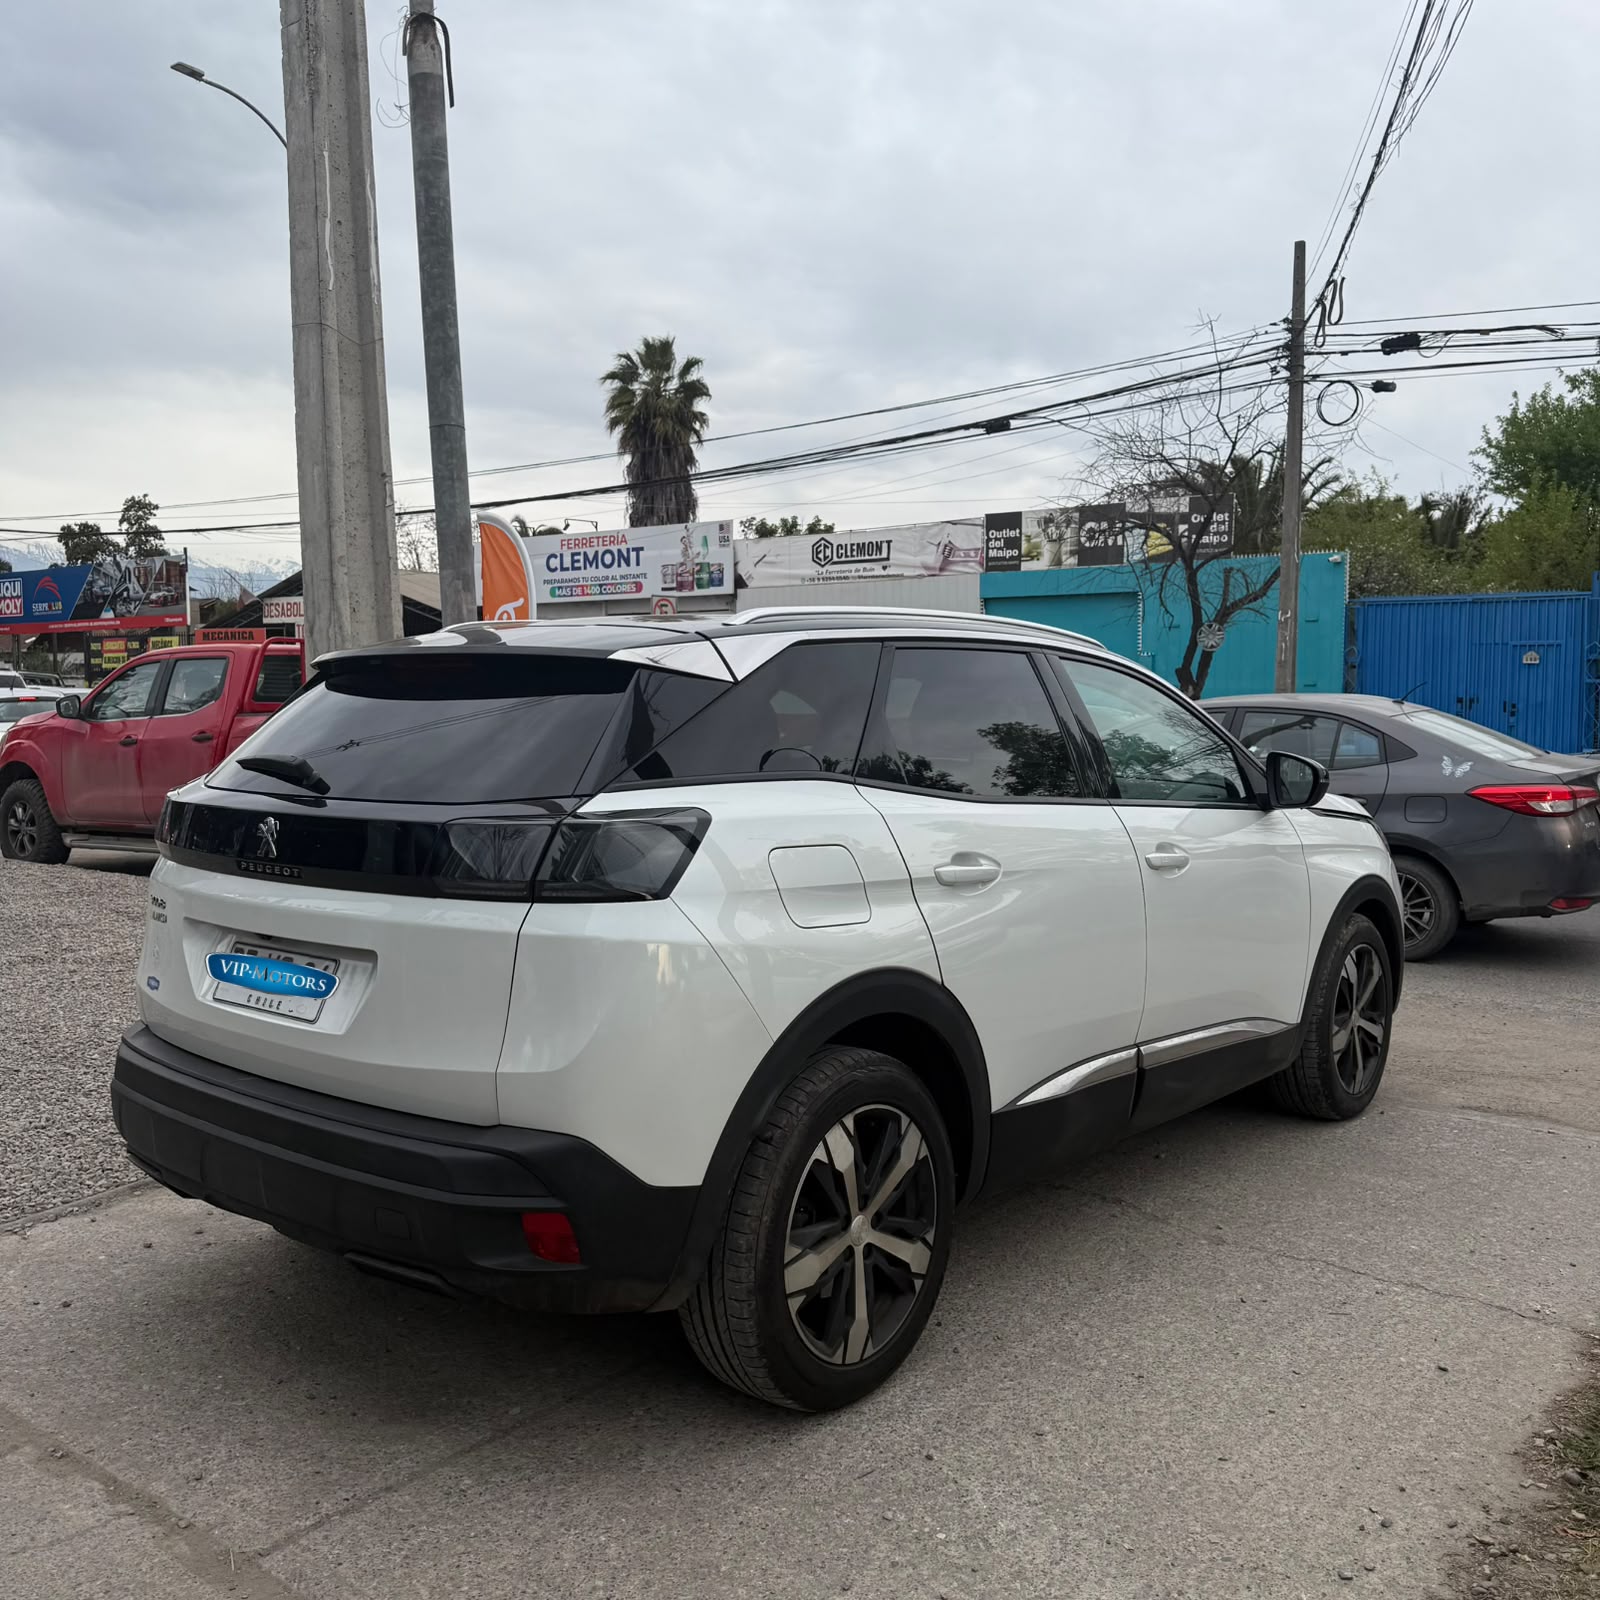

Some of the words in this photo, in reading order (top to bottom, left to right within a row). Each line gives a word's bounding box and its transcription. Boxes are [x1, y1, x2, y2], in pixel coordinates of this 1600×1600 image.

[1191, 512, 1229, 522] Olet
[989, 528, 1020, 538] Outlet
[560, 532, 628, 550] FERRETERÍA
[989, 539, 1004, 548] del
[836, 540, 893, 560] CLEMONT
[989, 548, 1019, 559] Maipo
[546, 547, 644, 573] CLEMONT
[543, 578, 580, 586] PREPARAMOS
[619, 572, 647, 580] INSTANTE
[572, 586, 582, 595] DE
[584, 585, 600, 595] 1400
[601, 583, 636, 594] COLORES
[241, 861, 300, 877] PEUGEOT
[247, 994, 282, 1010] CHILE
